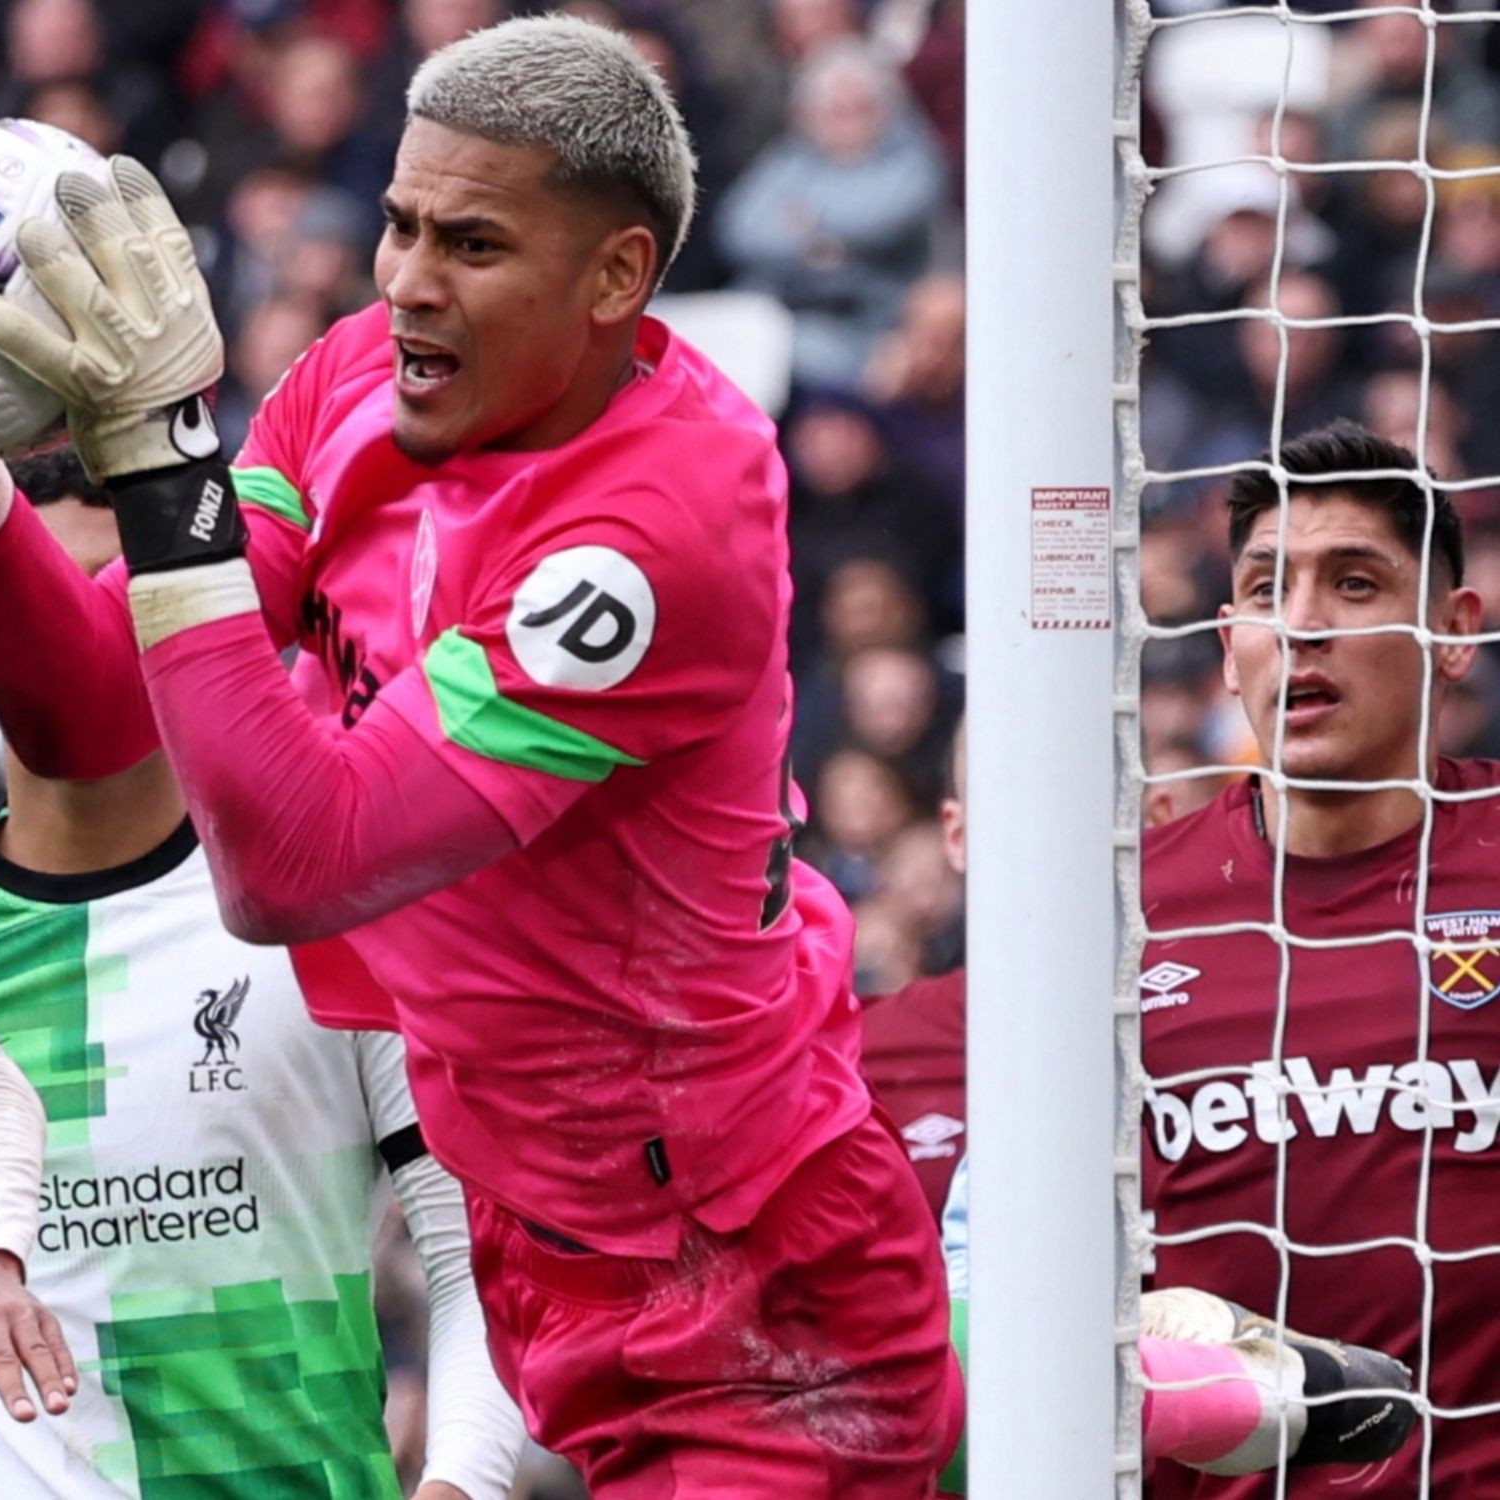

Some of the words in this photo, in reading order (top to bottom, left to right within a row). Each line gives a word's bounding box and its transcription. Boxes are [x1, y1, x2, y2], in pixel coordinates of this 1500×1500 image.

[1033, 491, 1107, 501] IMPORTANT
[190, 479, 225, 542] FONZI
[1034, 520, 1073, 528] CHECK
[1034, 553, 1095, 562] LUBRICATE
[1034, 587, 1076, 595] REPAIR
[518, 578, 637, 664] JD
[1427, 917, 1466, 932] WEST
[1443, 926, 1489, 938] UNITED
[1141, 991, 1190, 1013] umbro
[188, 1068, 248, 1092] L.F.C.
[39, 1157, 244, 1212] standard
[38, 1195, 259, 1252] chartered
